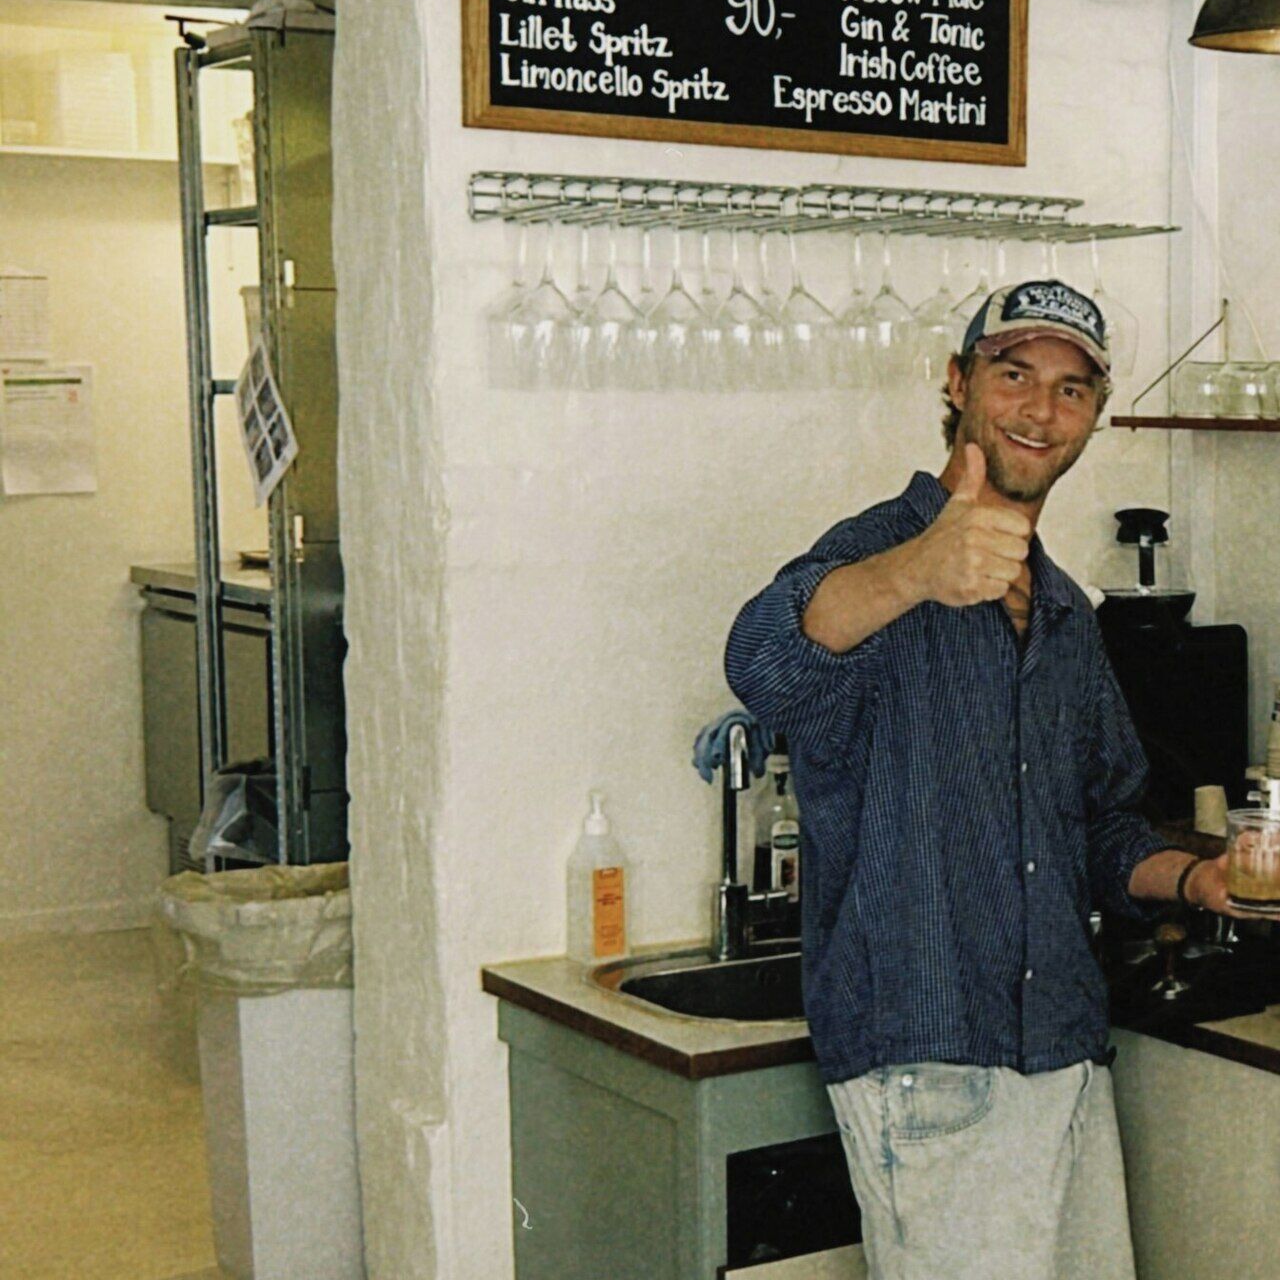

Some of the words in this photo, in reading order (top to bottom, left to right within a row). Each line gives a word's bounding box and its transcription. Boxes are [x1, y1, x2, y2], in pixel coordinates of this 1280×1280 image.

[500, 12, 578, 53] Lillet
[589, 21, 673, 67] Spritz
[841, 6, 884, 43] Gin
[892, 9, 911, 43] &
[920, 12, 986, 51] Tonic
[500, 52, 643, 97] Limoncello
[651, 67, 730, 114] Spritz
[839, 42, 896, 81] Irish
[900, 50, 983, 86] Coffee
[773, 74, 893, 124] Espresso
[899, 86, 987, 126] Martini
